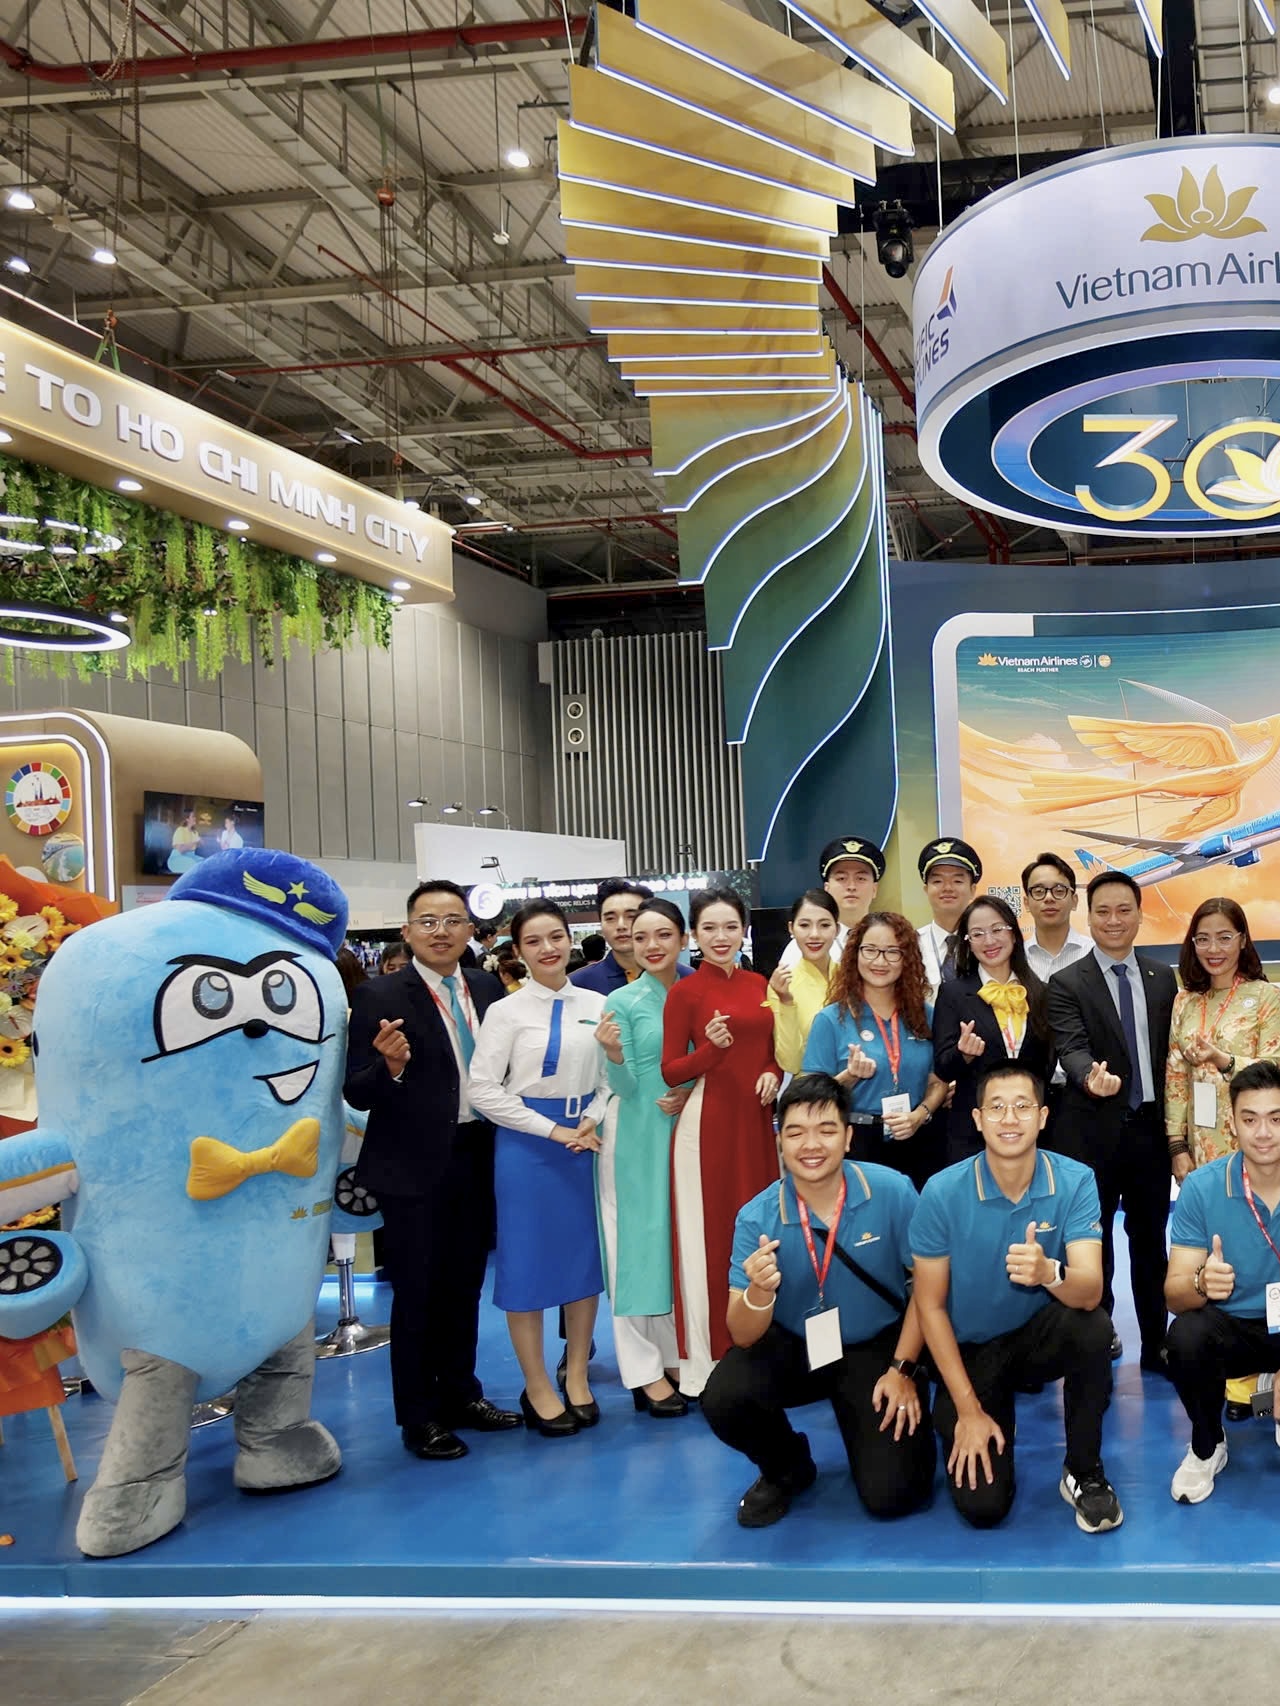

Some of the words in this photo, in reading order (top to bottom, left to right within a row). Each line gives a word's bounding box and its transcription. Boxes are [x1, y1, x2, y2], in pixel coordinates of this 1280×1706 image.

[1056, 261, 1211, 310] Vietnam
[25, 363, 102, 428] TO
[117, 403, 184, 462] HO
[199, 441, 259, 495] CHI
[269, 470, 357, 536] MINH
[364, 513, 430, 563] CITY
[997, 655, 1041, 667] Vietnam
[1040, 655, 1078, 666] Airlines
